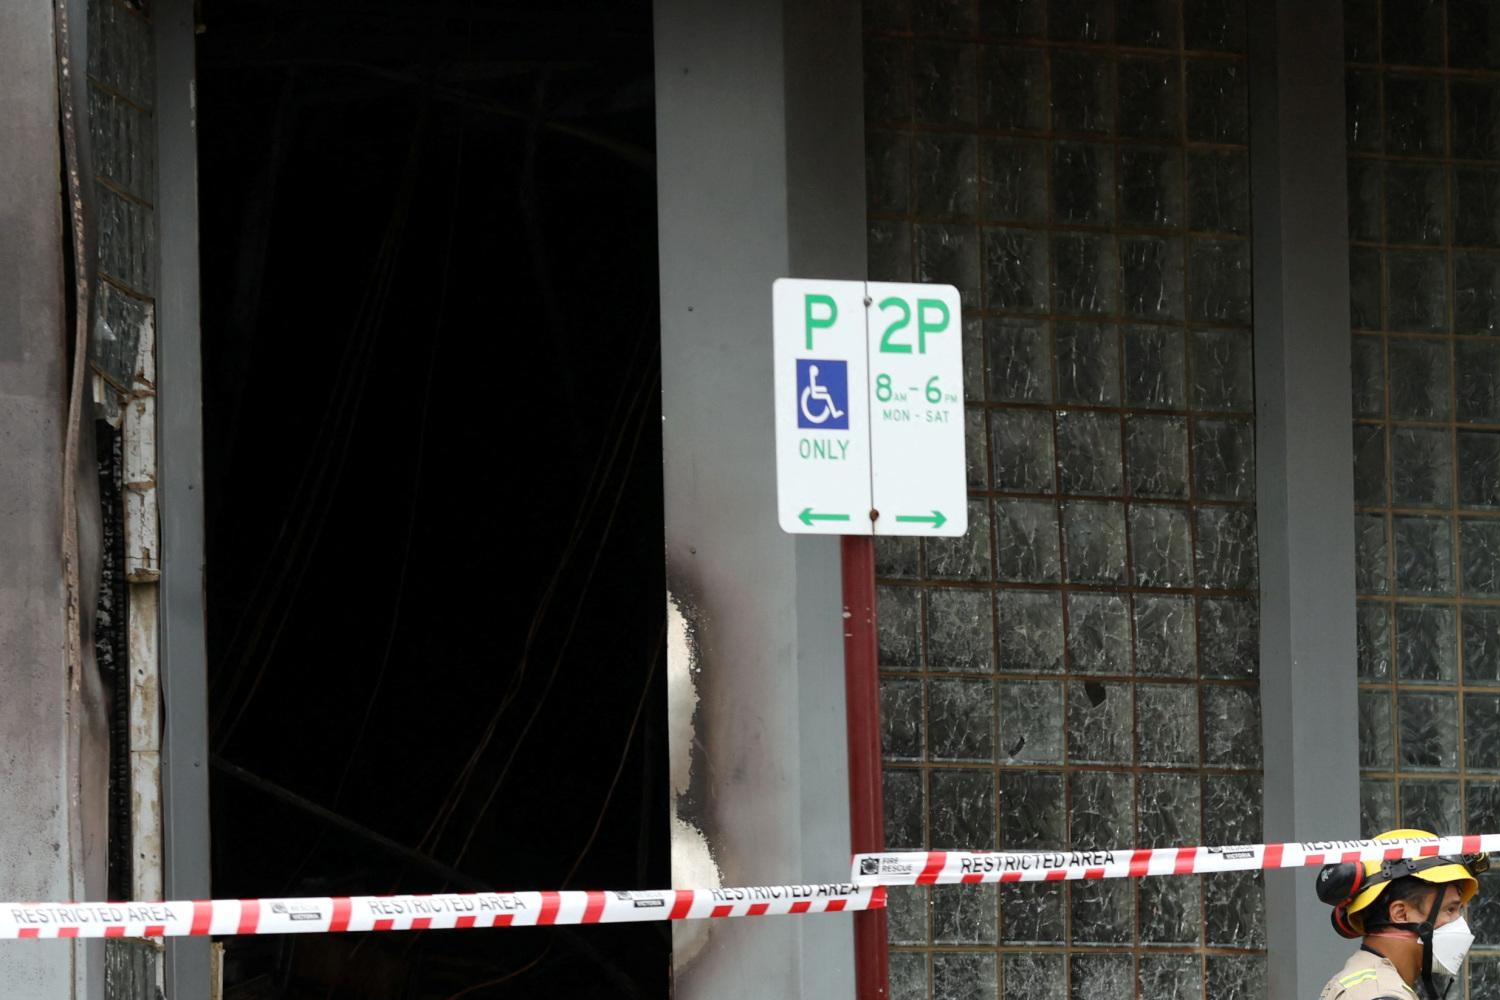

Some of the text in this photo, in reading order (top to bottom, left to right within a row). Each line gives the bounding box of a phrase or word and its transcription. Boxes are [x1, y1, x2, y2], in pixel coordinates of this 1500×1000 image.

[804, 294, 839, 350] P
[878, 297, 951, 354] 2P
[882, 409, 910, 421] MON
[926, 410, 950, 423] SAT
[799, 438, 850, 460] ONLY
[961, 850, 1115, 873] RESTRICTED AREA
[712, 882, 860, 901] RESTRICTED AREA
[11, 906, 177, 924] RESTRICTED AREA
[368, 896, 527, 915] RESTRICTED AREA
